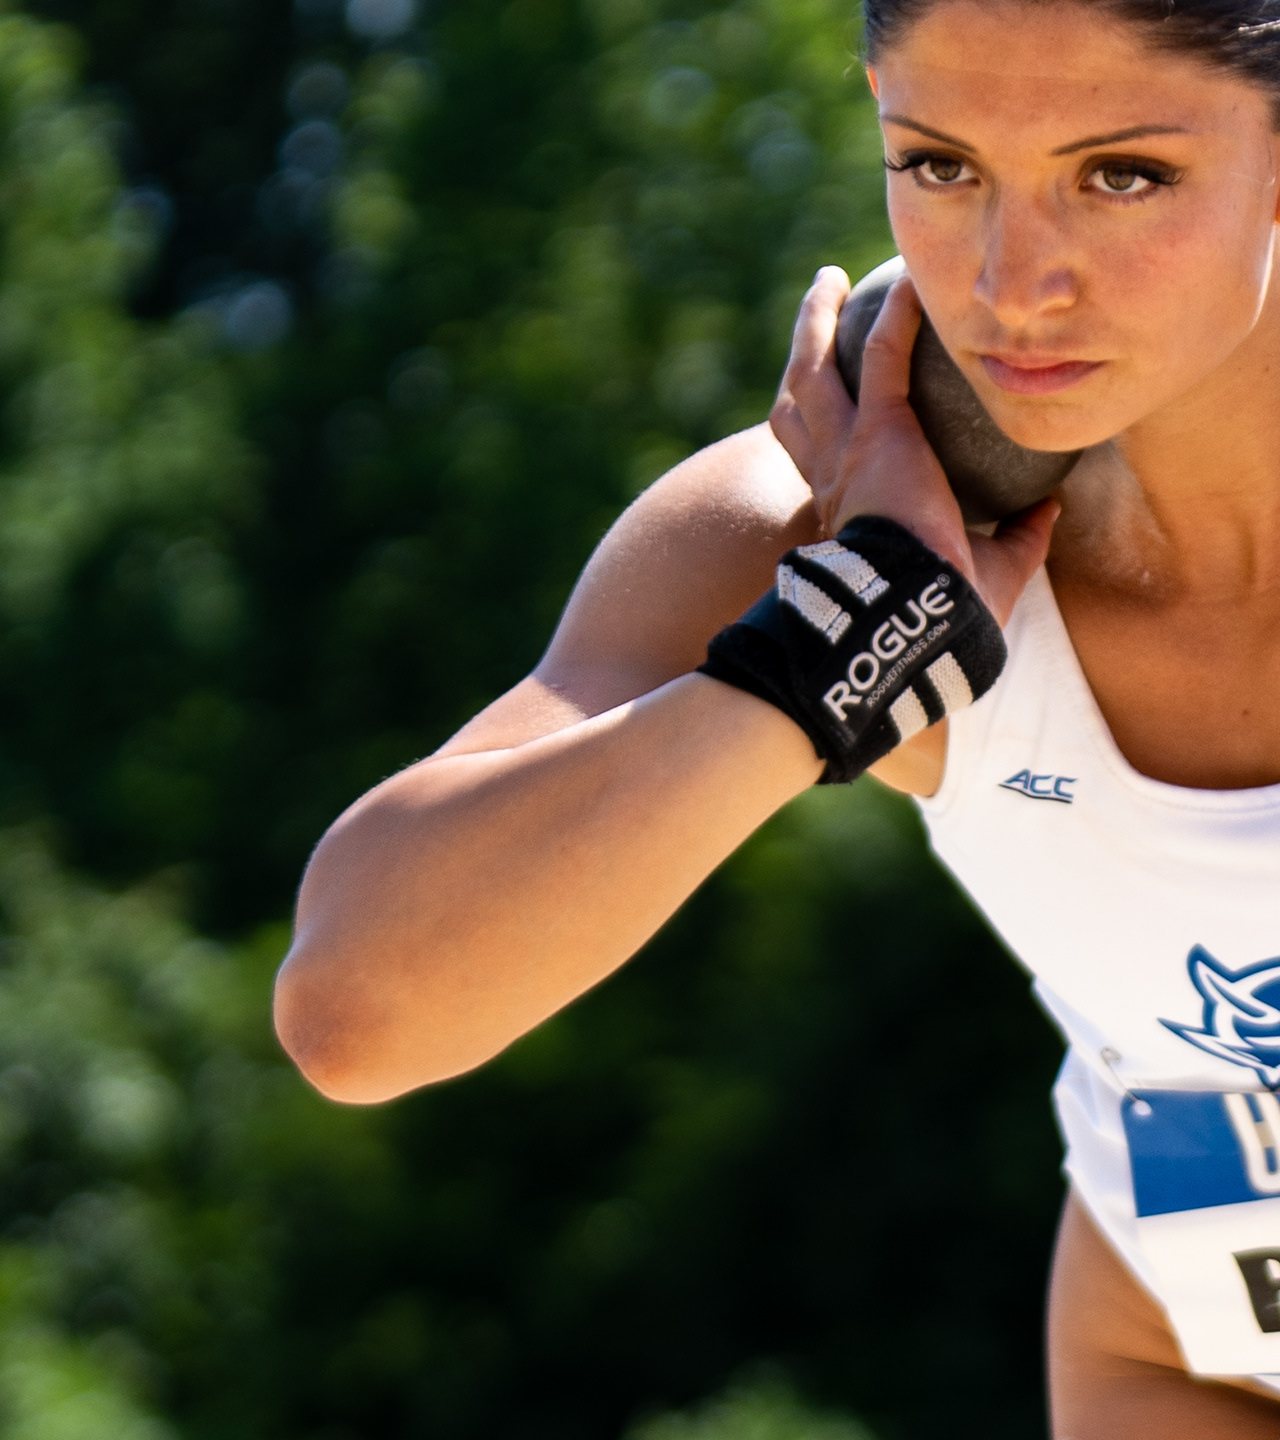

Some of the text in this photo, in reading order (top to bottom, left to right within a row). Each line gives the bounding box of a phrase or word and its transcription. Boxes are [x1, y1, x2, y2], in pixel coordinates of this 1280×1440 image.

[823, 581, 954, 722] ROGUE
[863, 619, 951, 710] ROGUEFITNESS.COM
[1003, 768, 1078, 799] ACC
